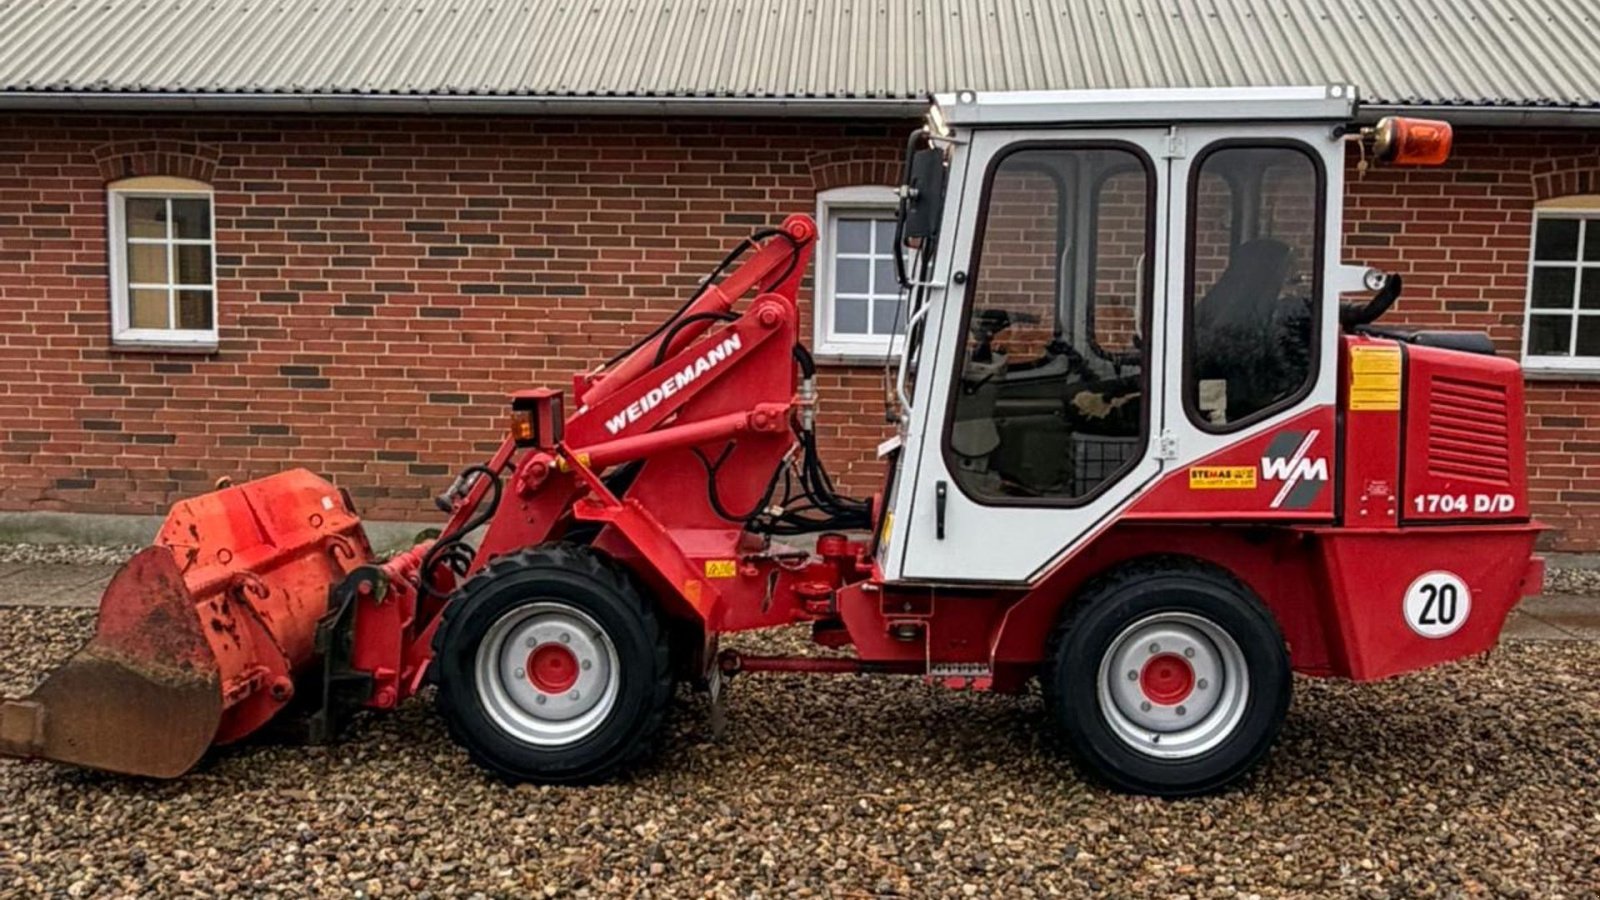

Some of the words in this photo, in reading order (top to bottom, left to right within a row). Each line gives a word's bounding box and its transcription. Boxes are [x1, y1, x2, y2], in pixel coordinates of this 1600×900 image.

[605, 333, 742, 435] WEIDEMANN
[1191, 469, 1231, 479] STEMAS
[1414, 493, 1469, 513] 1704
[1474, 493, 1515, 514] D/D
[1418, 583, 1458, 625] 20
